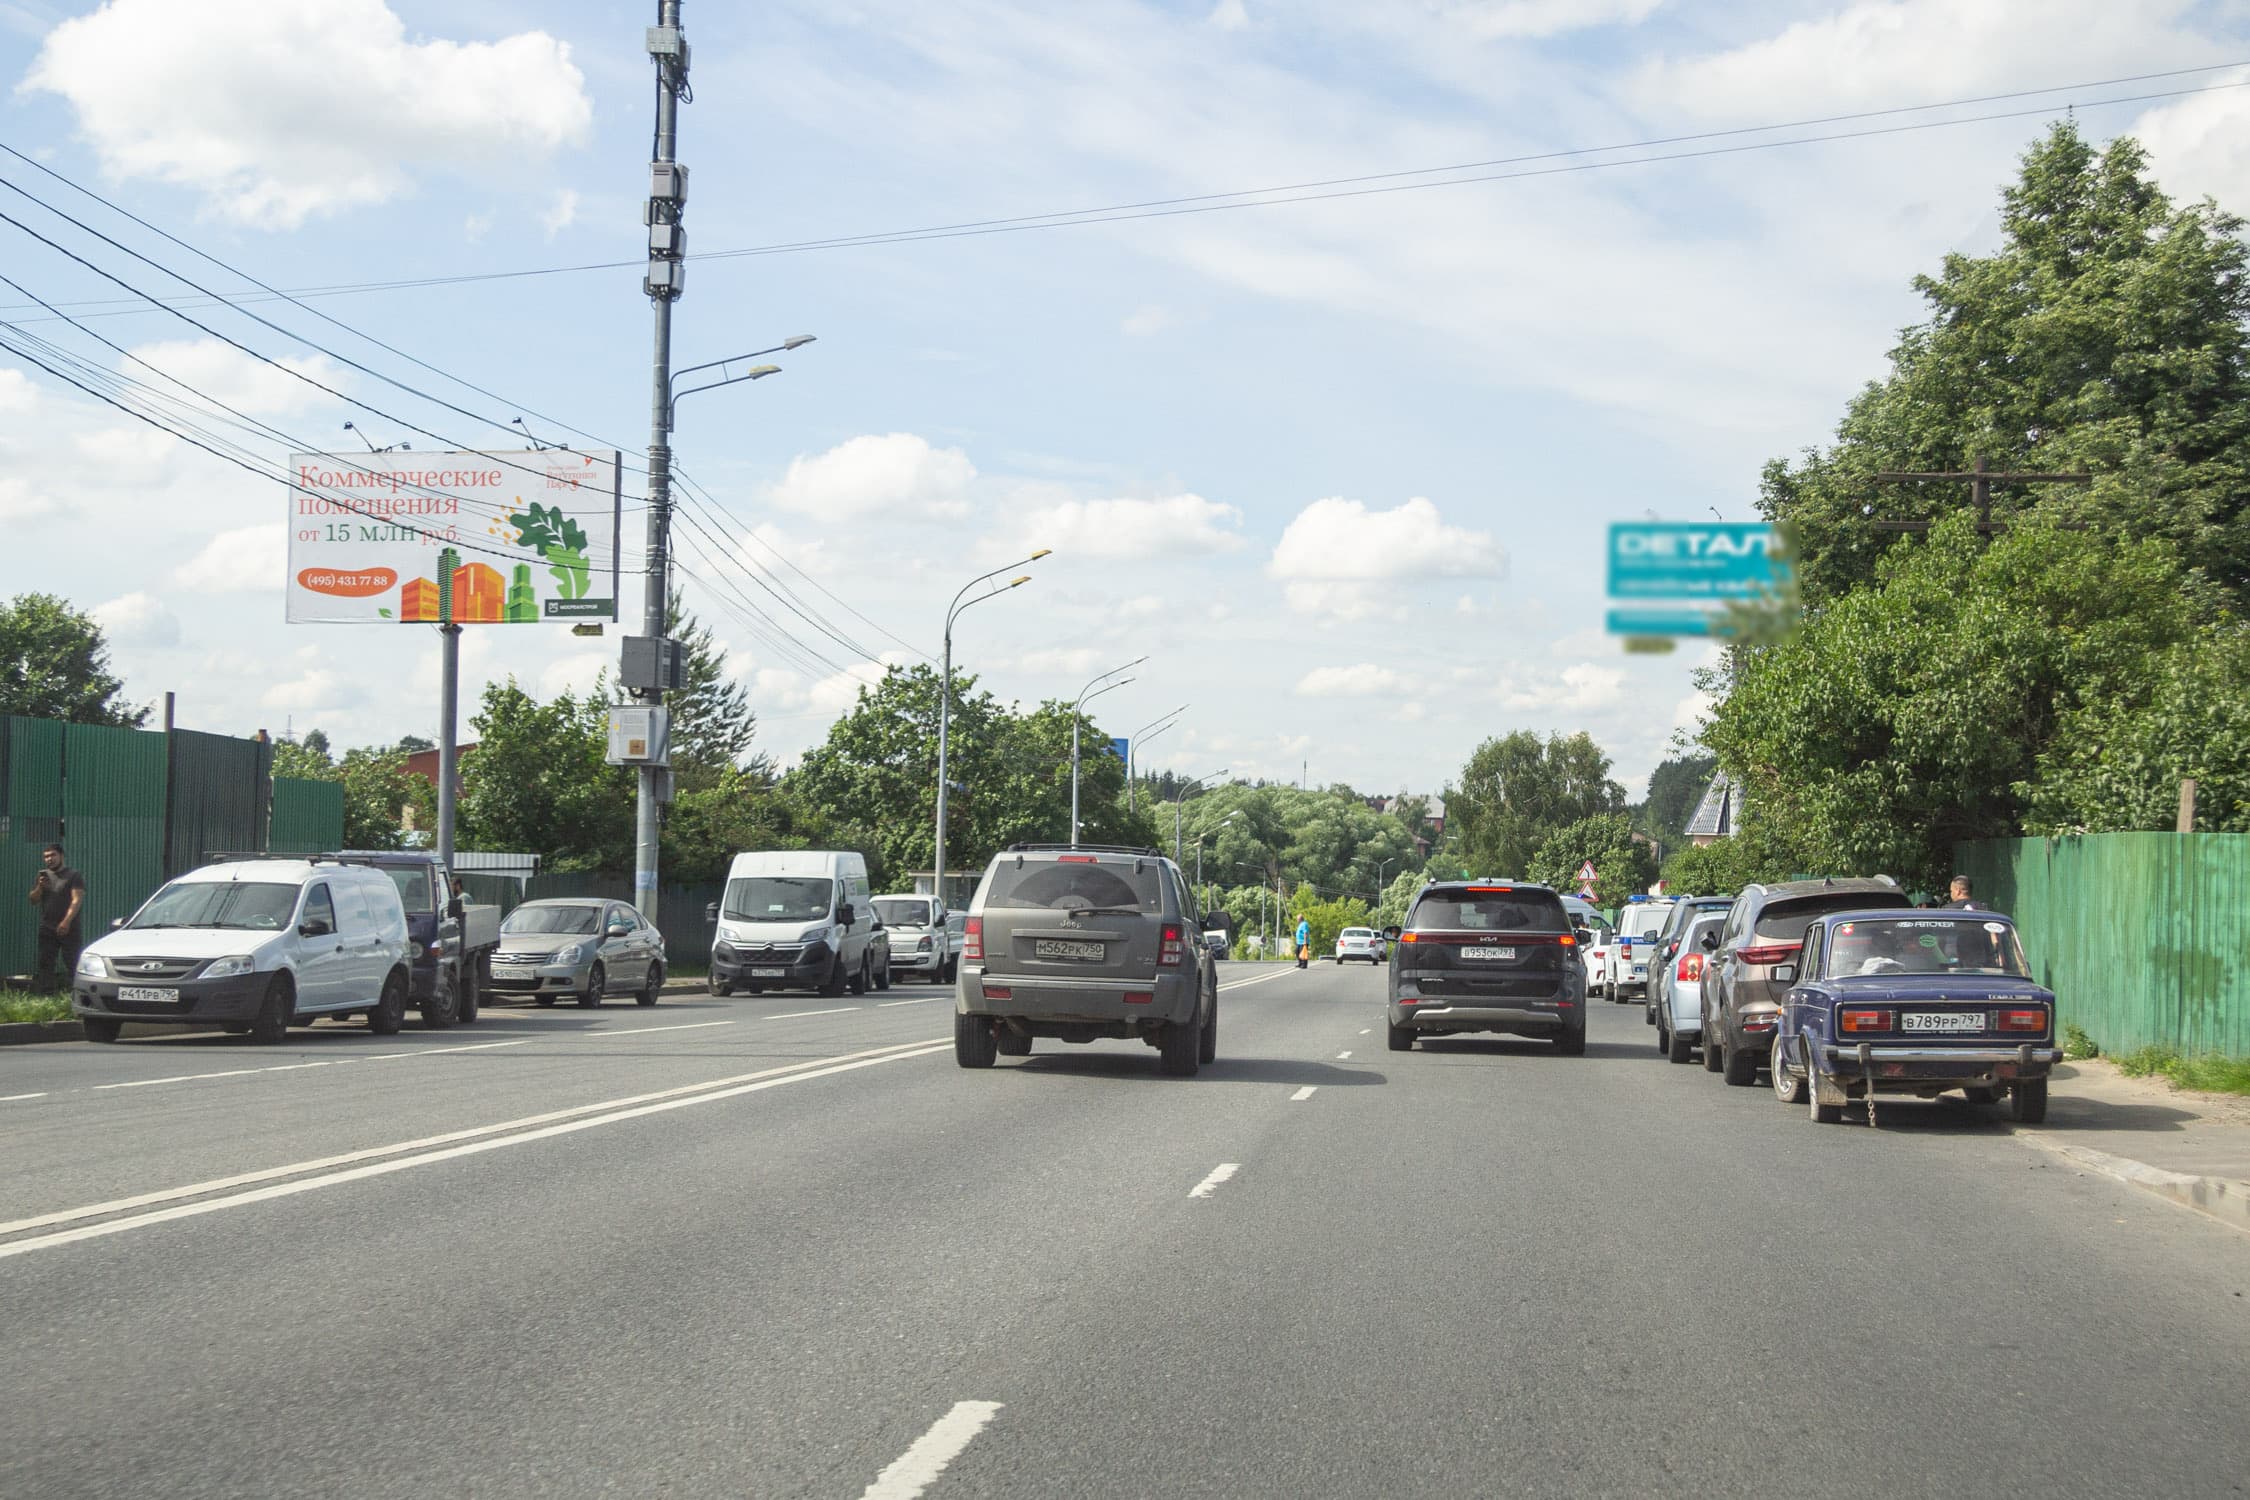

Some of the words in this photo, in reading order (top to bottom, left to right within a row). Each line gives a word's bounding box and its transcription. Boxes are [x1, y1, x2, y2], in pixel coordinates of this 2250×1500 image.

[299, 465, 503, 494] Коммерческие
[298, 498, 459, 521] помещения
[298, 529, 320, 542] от
[325, 524, 351, 542] 15
[421, 525, 461, 546] руб.
[307, 573, 336, 588] (495)
[337, 576, 357, 586] 431
[359, 576, 372, 586] 77
[373, 576, 388, 586] 88
[1060, 920, 1082, 929] Jeep
[1037, 943, 1082, 955] М562РК
[1084, 944, 1102, 953] 750
[1906, 1015, 1958, 1028] В789РР
[1961, 1014, 1981, 1024] 797
